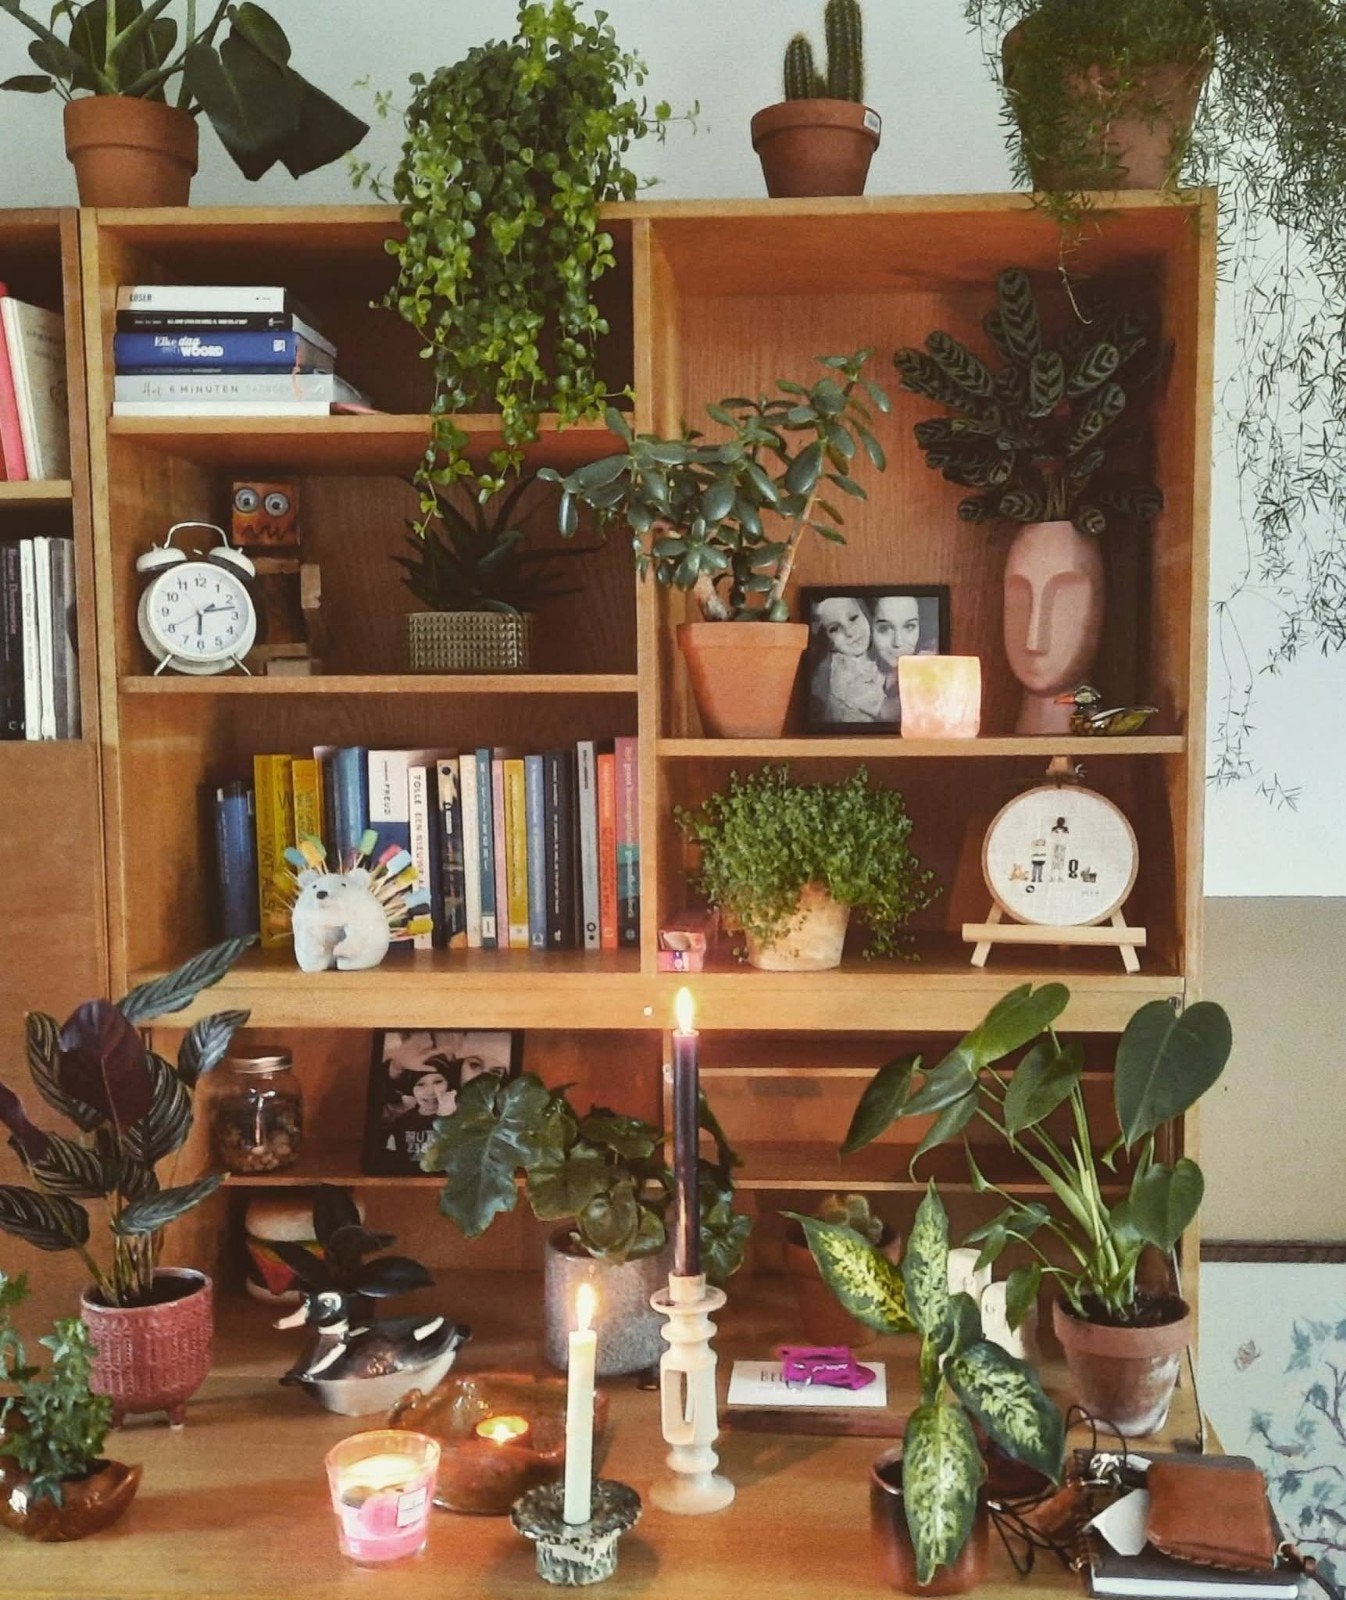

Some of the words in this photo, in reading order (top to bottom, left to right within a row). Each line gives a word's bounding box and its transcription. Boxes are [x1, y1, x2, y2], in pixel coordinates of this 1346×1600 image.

[180, 384, 239, 394] MINUTEN
[178, 580, 188, 591] 11
[194, 577, 206, 588] 12
[215, 584, 220, 593] 1
[167, 592, 179, 602] 10
[225, 595, 233, 604] 2
[162, 607, 169, 617] 9
[232, 611, 239, 621] 3
[168, 624, 176, 633] 8
[226, 625, 233, 635] 4
[182, 635, 189, 644] 7
[215, 636, 222, 646] 5
[197, 640, 204, 650] 6
[413, 774, 422, 805] TOLLE
[383, 784, 391, 815] FREUD
